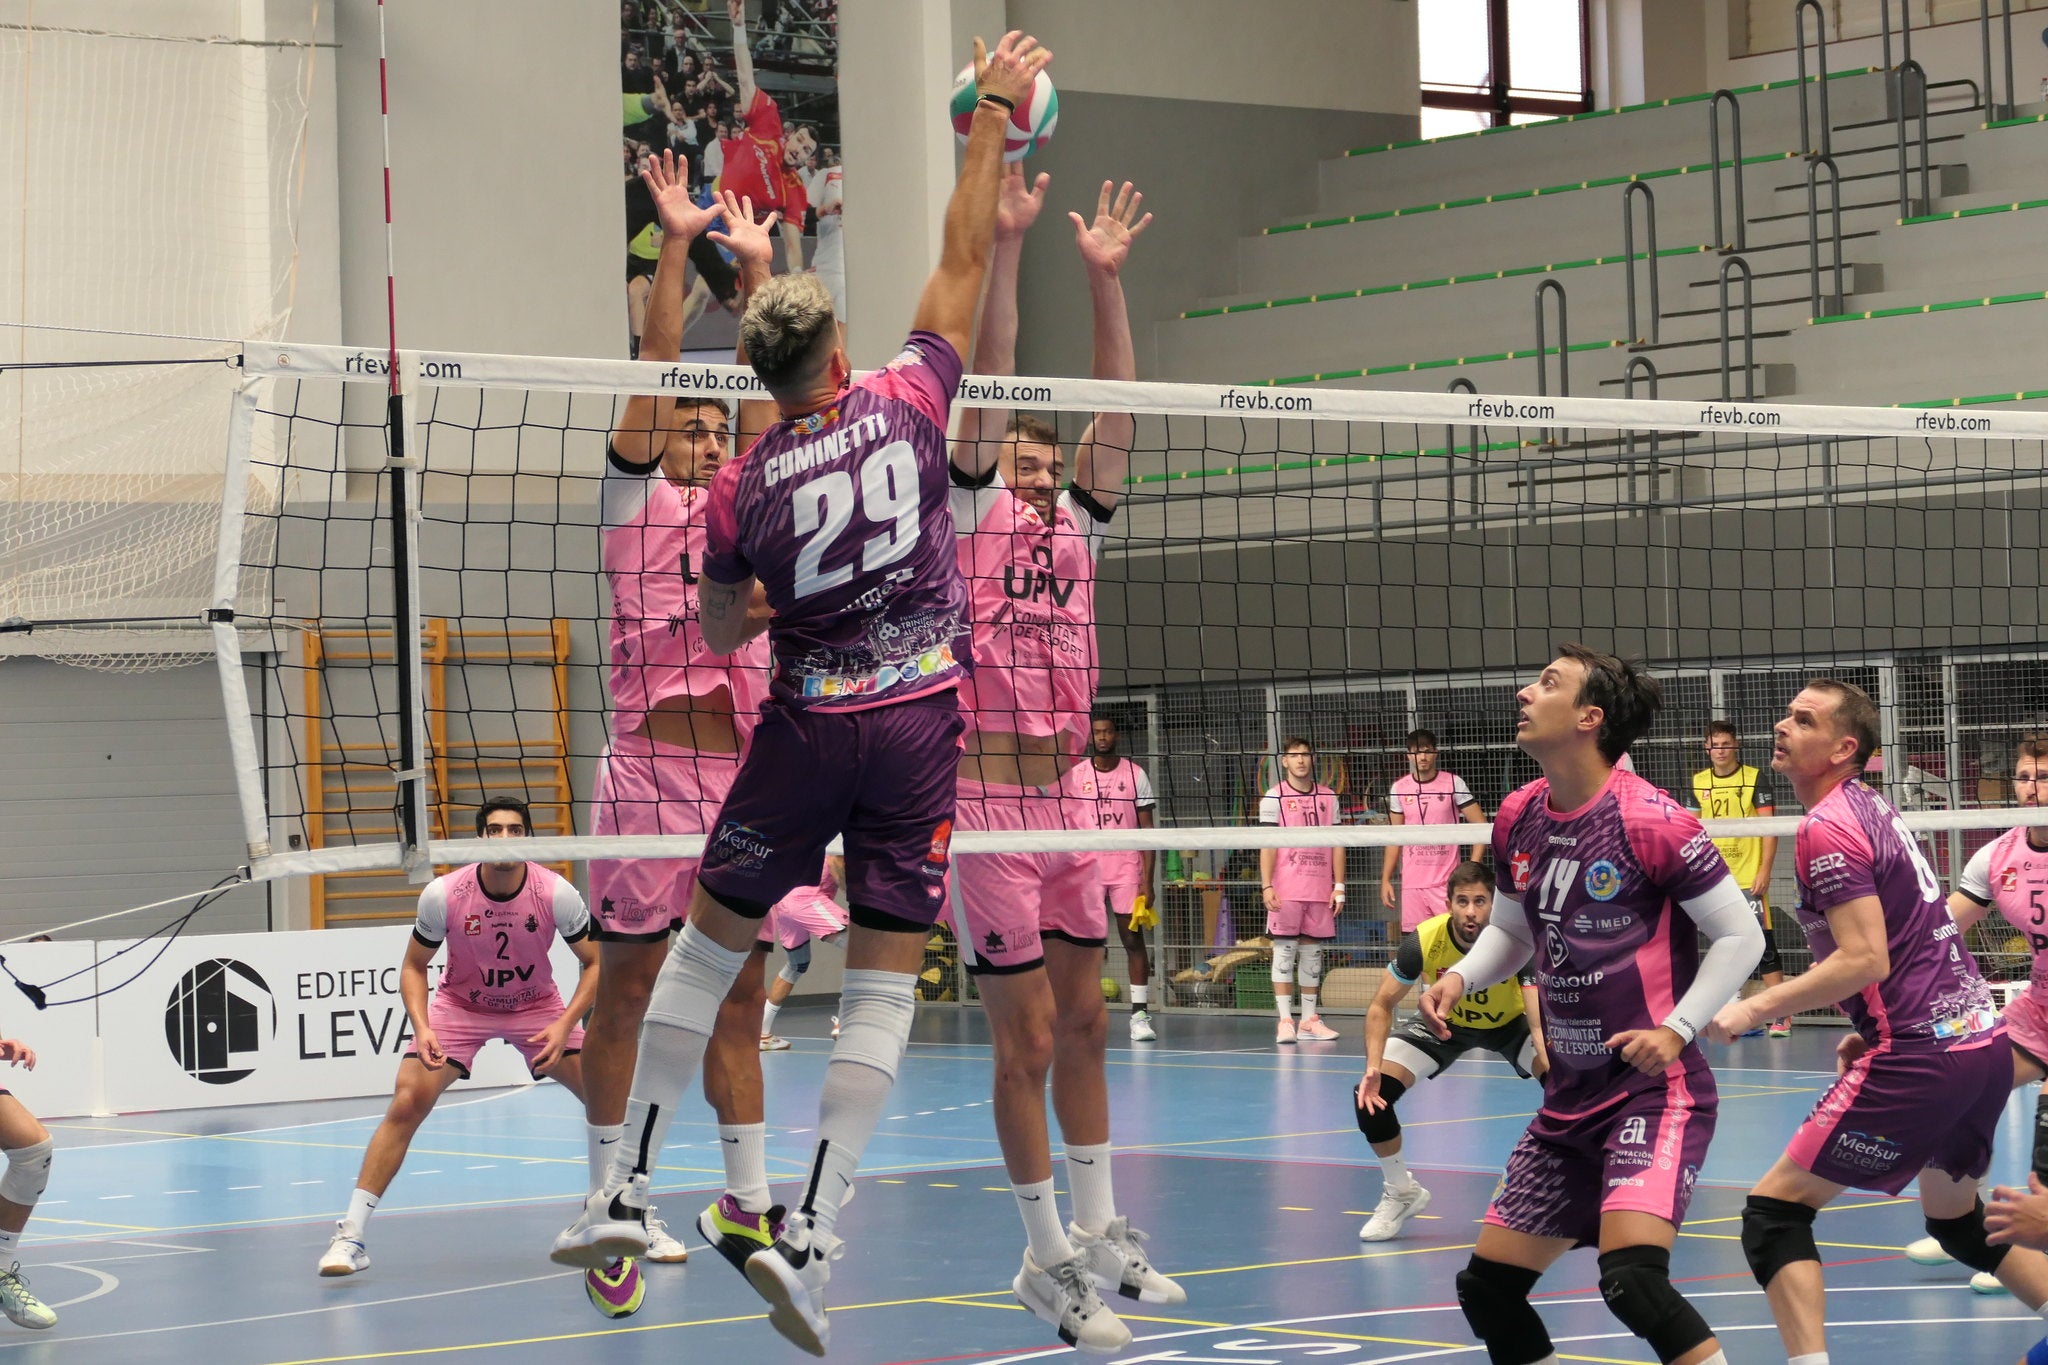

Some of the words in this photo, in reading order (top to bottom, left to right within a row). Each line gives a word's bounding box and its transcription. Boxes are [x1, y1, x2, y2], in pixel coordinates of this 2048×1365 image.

[345, 352, 462, 379] rfevom
[957, 379, 1052, 402] fevb.com
[1219, 391, 1313, 412] rfevb.com
[1468, 399, 1555, 420] rfevb.com
[1700, 406, 1781, 426] rfevb.com
[1915, 413, 1991, 432] rfevb.com
[764, 412, 887, 488] CUMINETTI
[792, 440, 921, 600] 29
[1004, 564, 1076, 608] UPV
[1713, 797, 1730, 817] 21
[1891, 816, 1940, 904] 8
[1538, 857, 1581, 913] 14
[1750, 899, 1764, 914] 21
[2030, 890, 2045, 926] 5
[1596, 915, 1632, 929] IMED
[495, 931, 510, 960] 2
[297, 964, 446, 1000] EDIFIC
[479, 964, 536, 988] UPV
[1548, 1025, 1602, 1041] COMUNITAT
[1553, 1040, 1565, 1054] DE
[1830, 1143, 1894, 1172] hoteles
[1837, 1132, 1902, 1161] Medsur
[1616, 1158, 1653, 1168] ALICANTE
